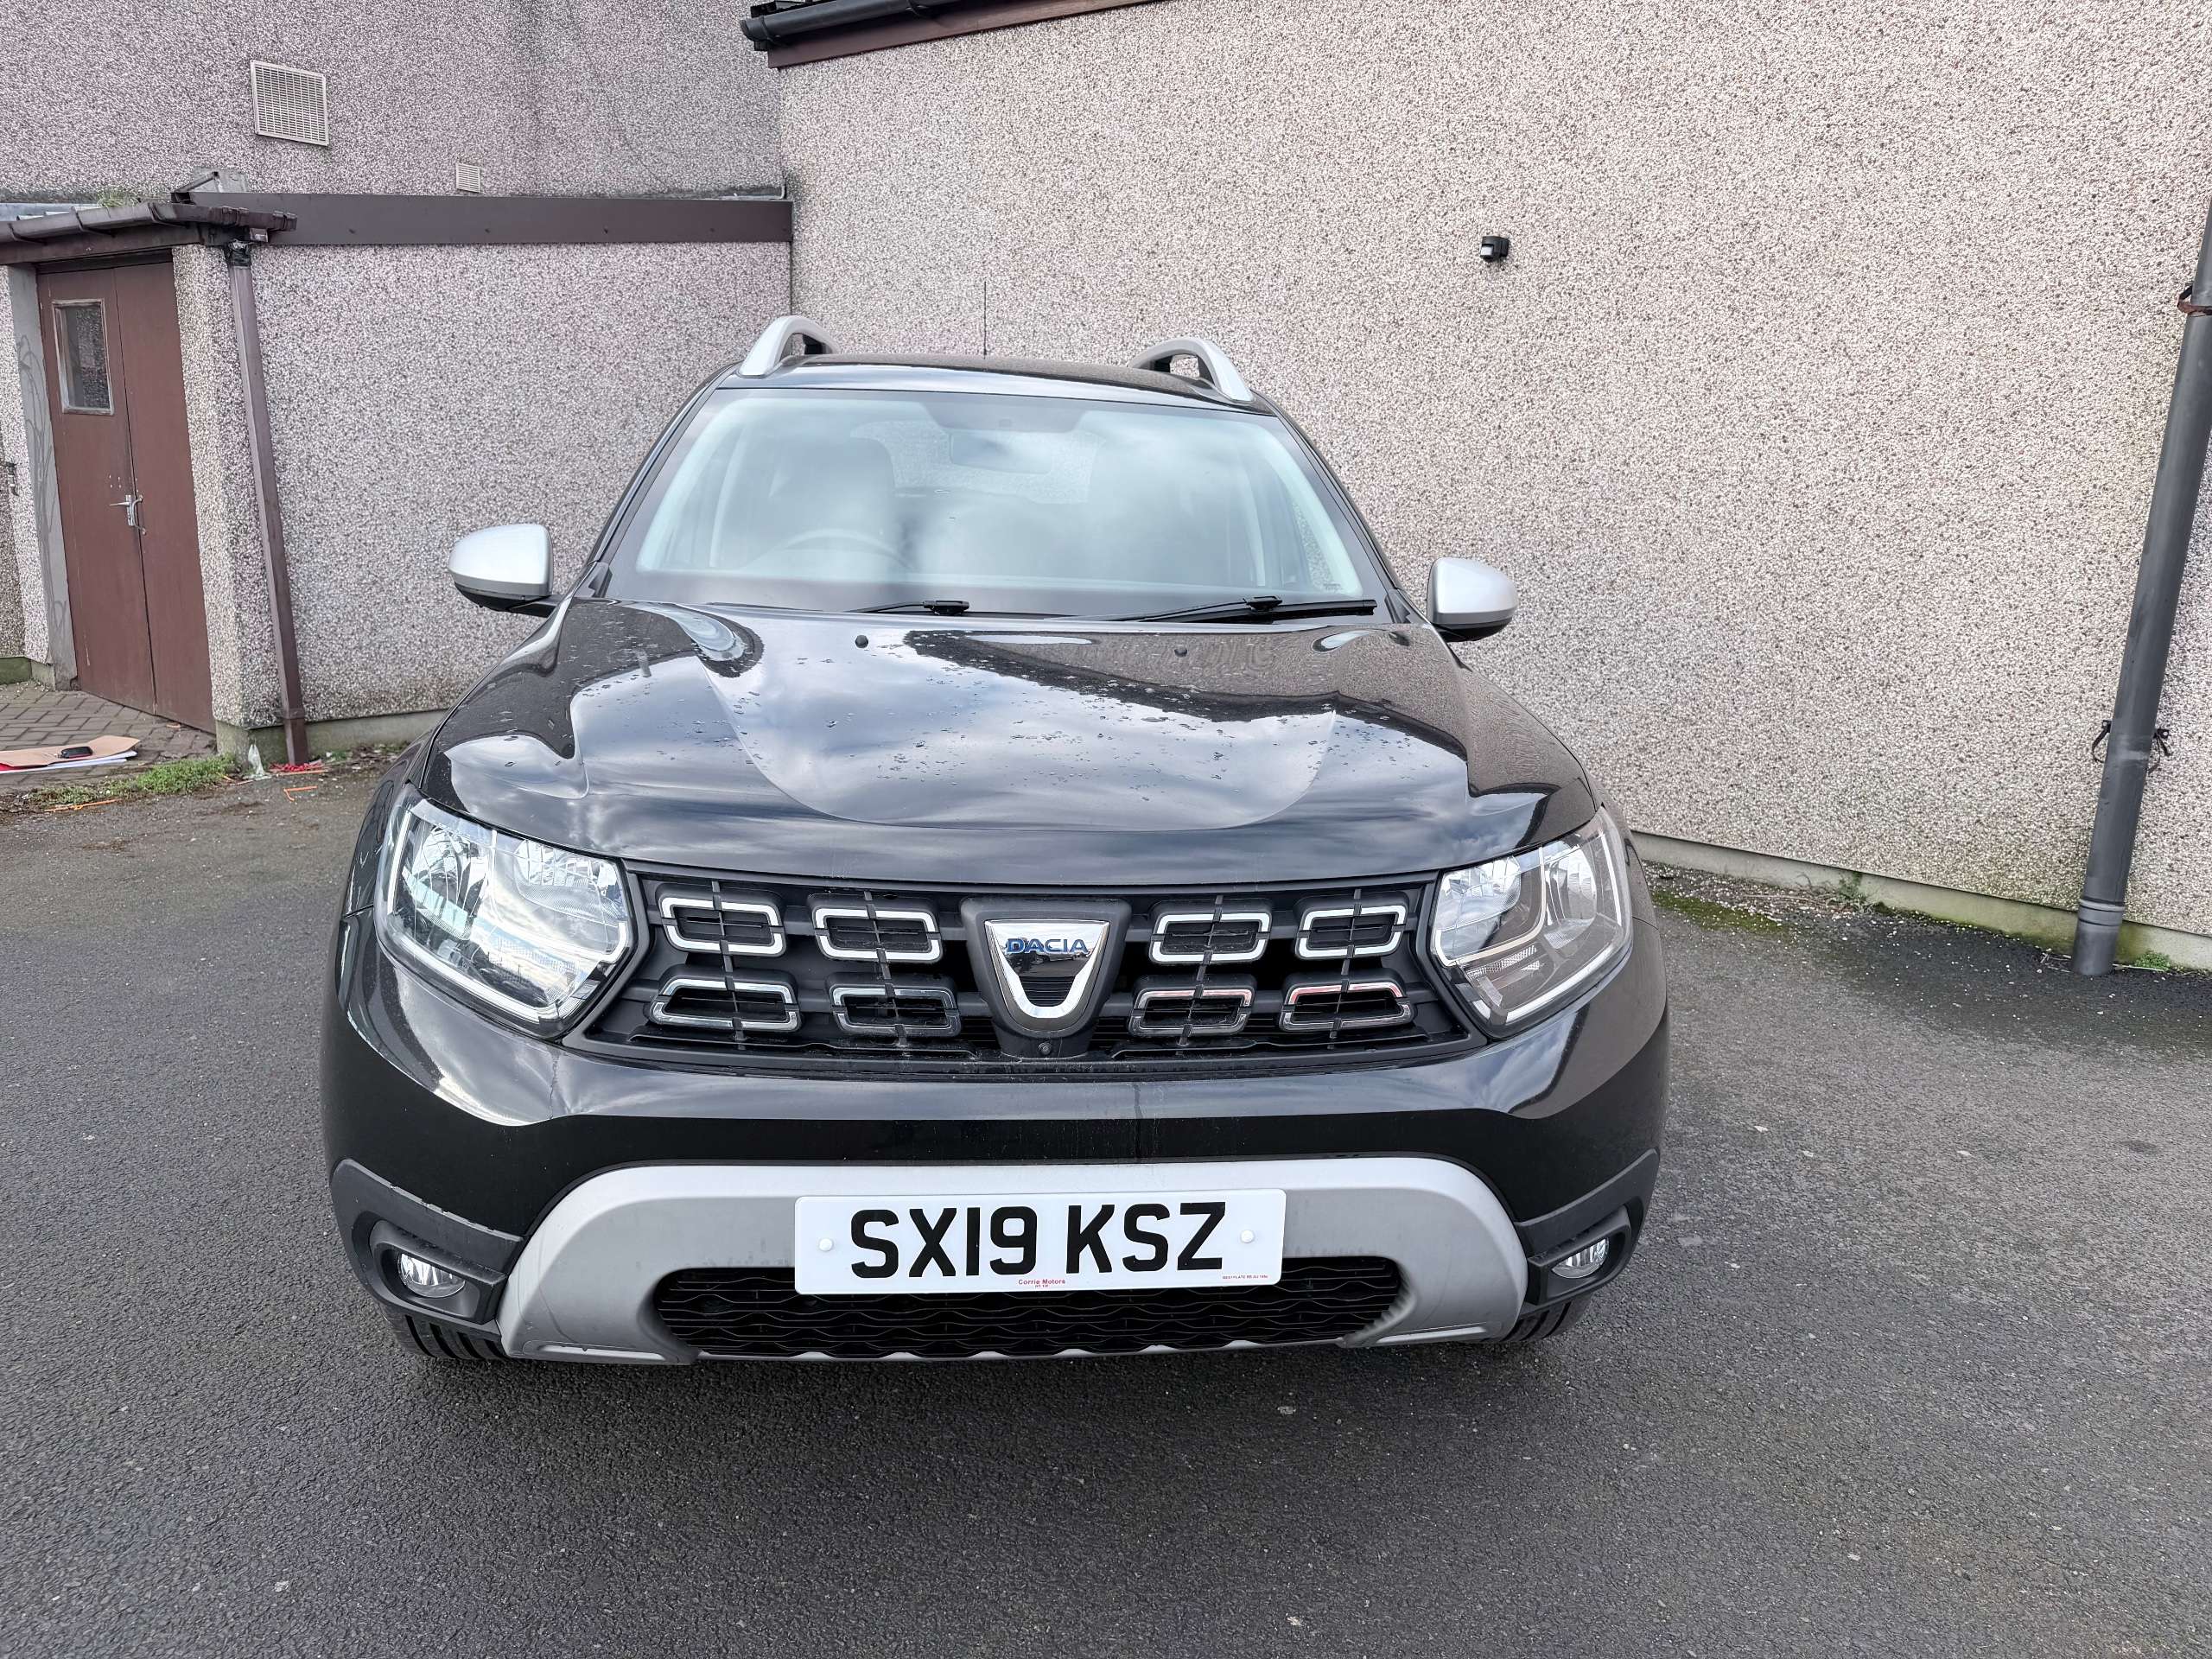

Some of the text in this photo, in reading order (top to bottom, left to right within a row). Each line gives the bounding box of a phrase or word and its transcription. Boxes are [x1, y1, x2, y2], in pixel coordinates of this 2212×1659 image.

[1007, 938, 1090, 954] DACIA
[850, 1201, 1226, 1279] SX19 KSZ
